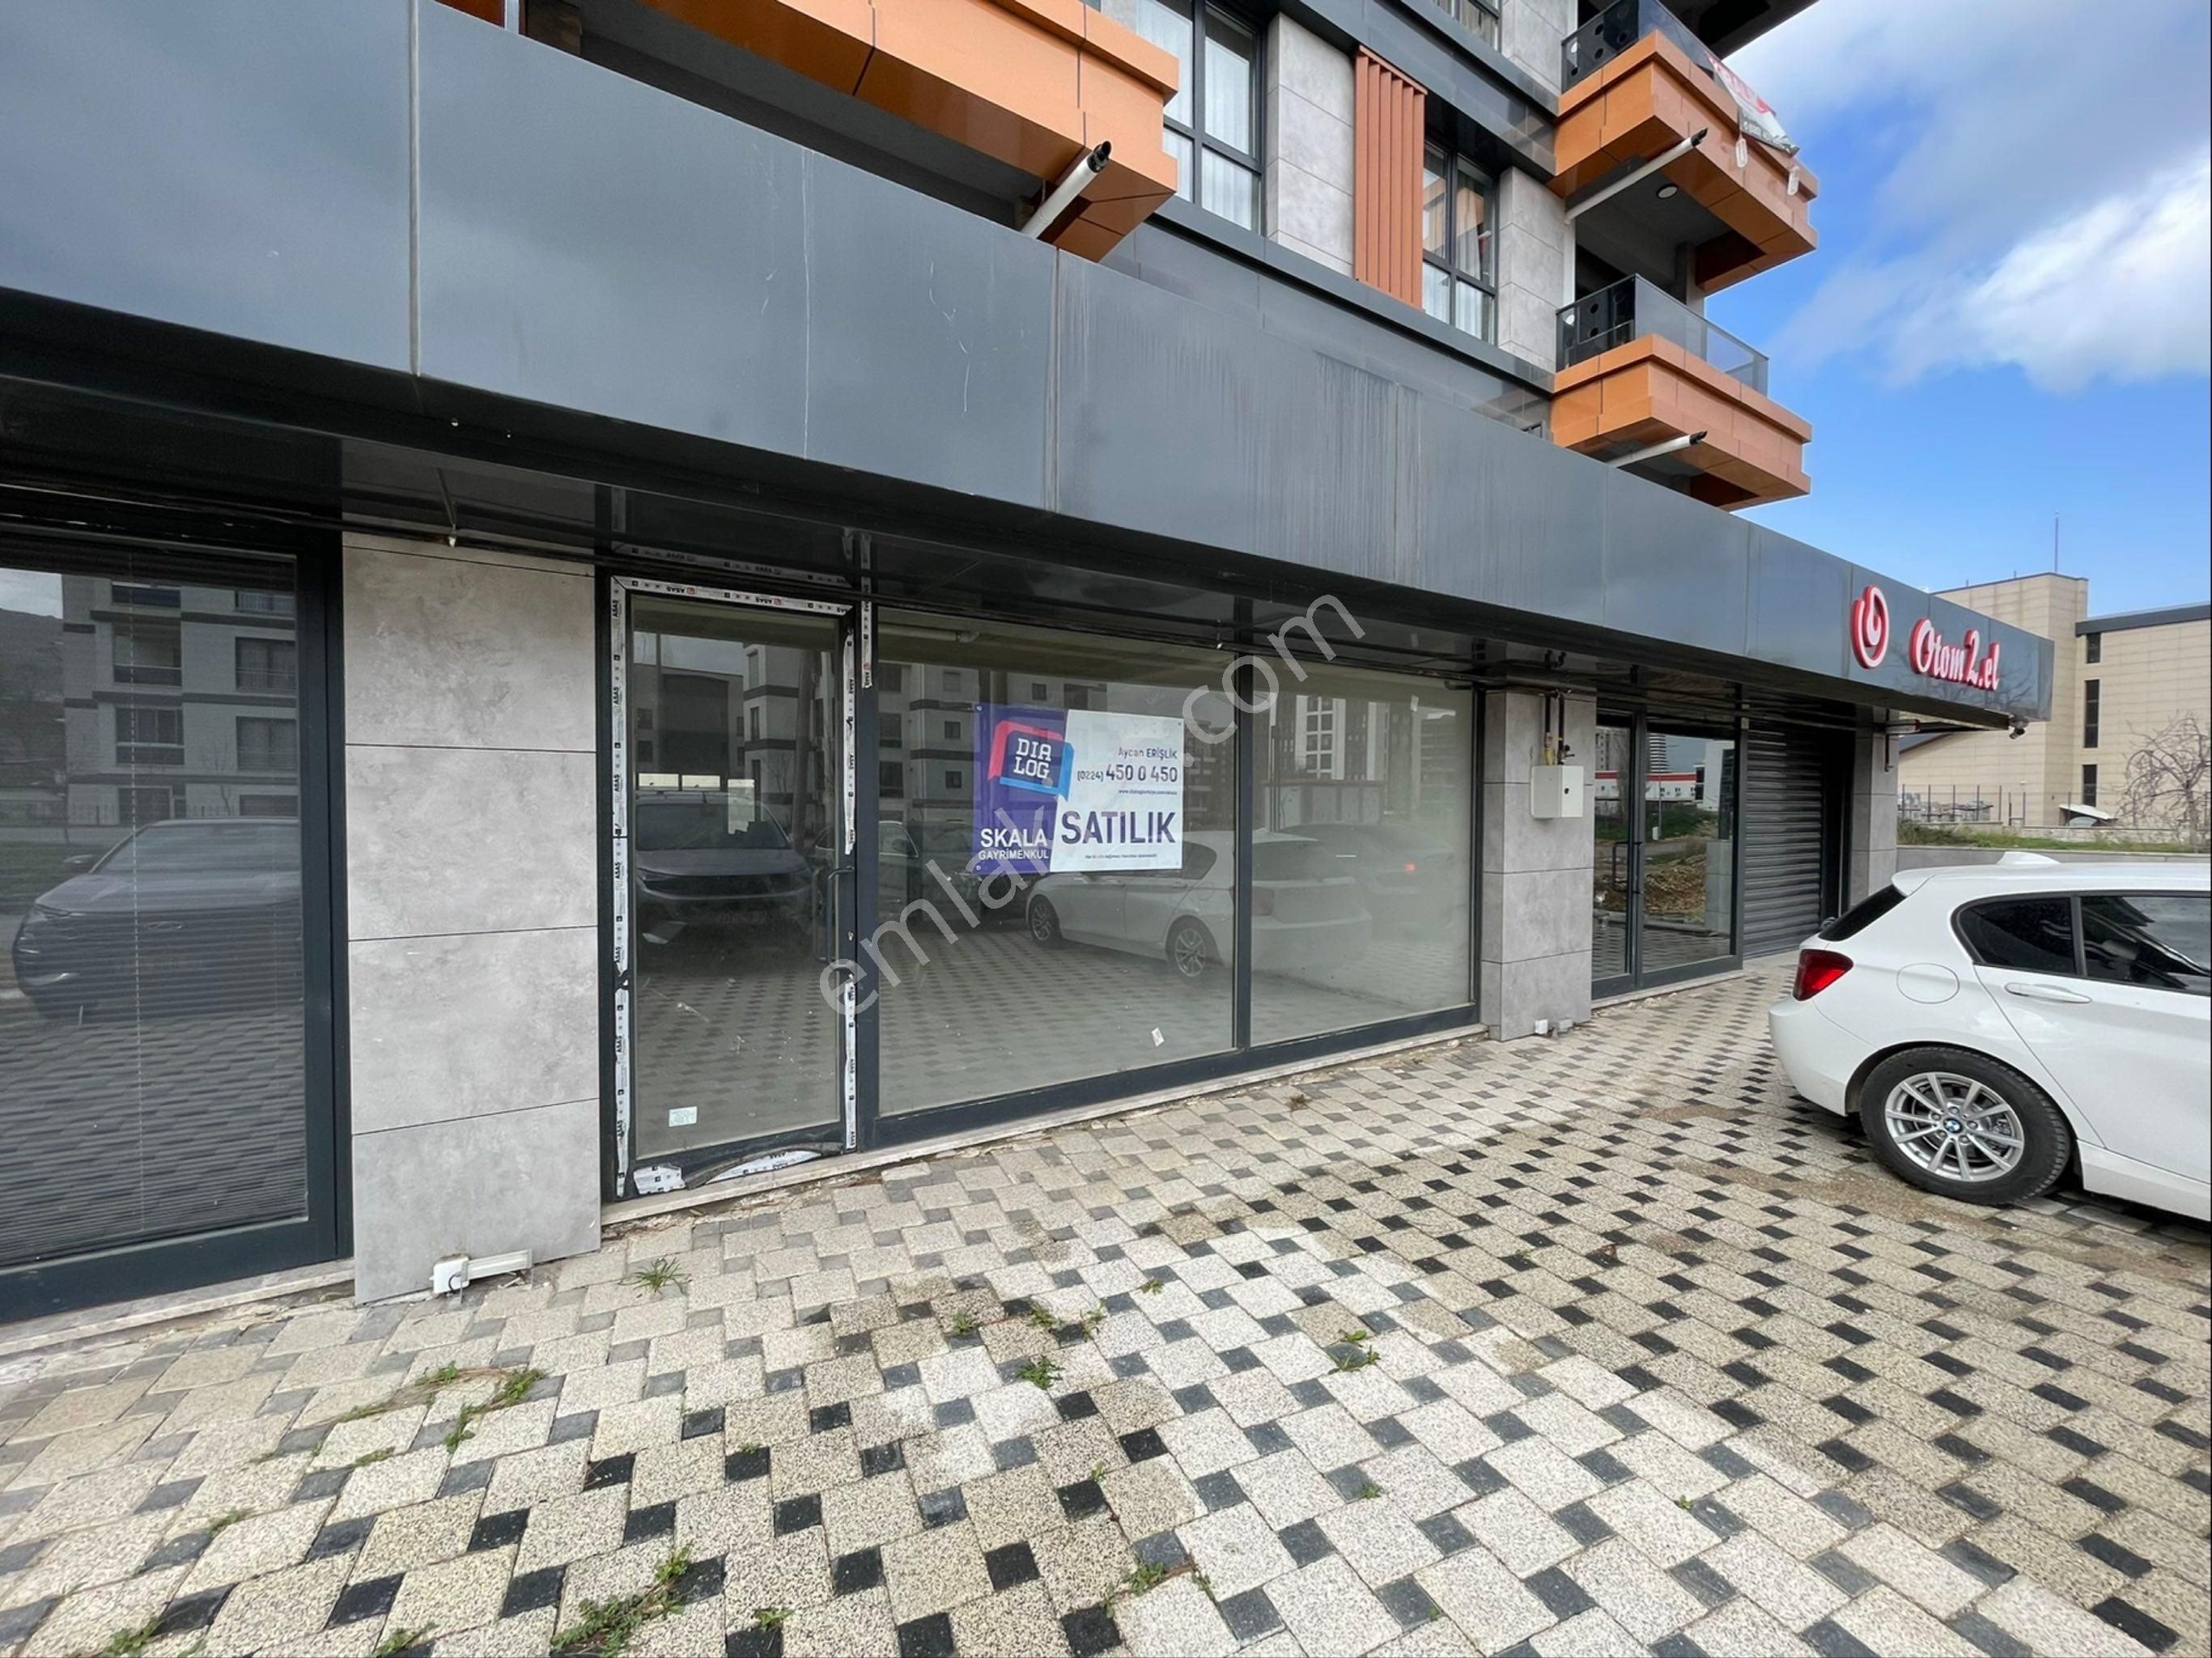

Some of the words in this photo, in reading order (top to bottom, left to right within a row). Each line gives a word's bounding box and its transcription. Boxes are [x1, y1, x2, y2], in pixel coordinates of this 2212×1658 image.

[1909, 617, 2001, 691] Otom2.el
[1016, 738, 1052, 761] DIA
[1013, 757, 1050, 779] LOG
[1077, 770, 1104, 782] (0224)
[1106, 764, 1134, 781] 450
[1138, 765, 1147, 781] 0
[1150, 765, 1178, 782] 450
[980, 828, 1047, 848] SKALA
[1061, 810, 1176, 844] SATILIK
[978, 849, 1050, 861] GAYRİMENKUL
